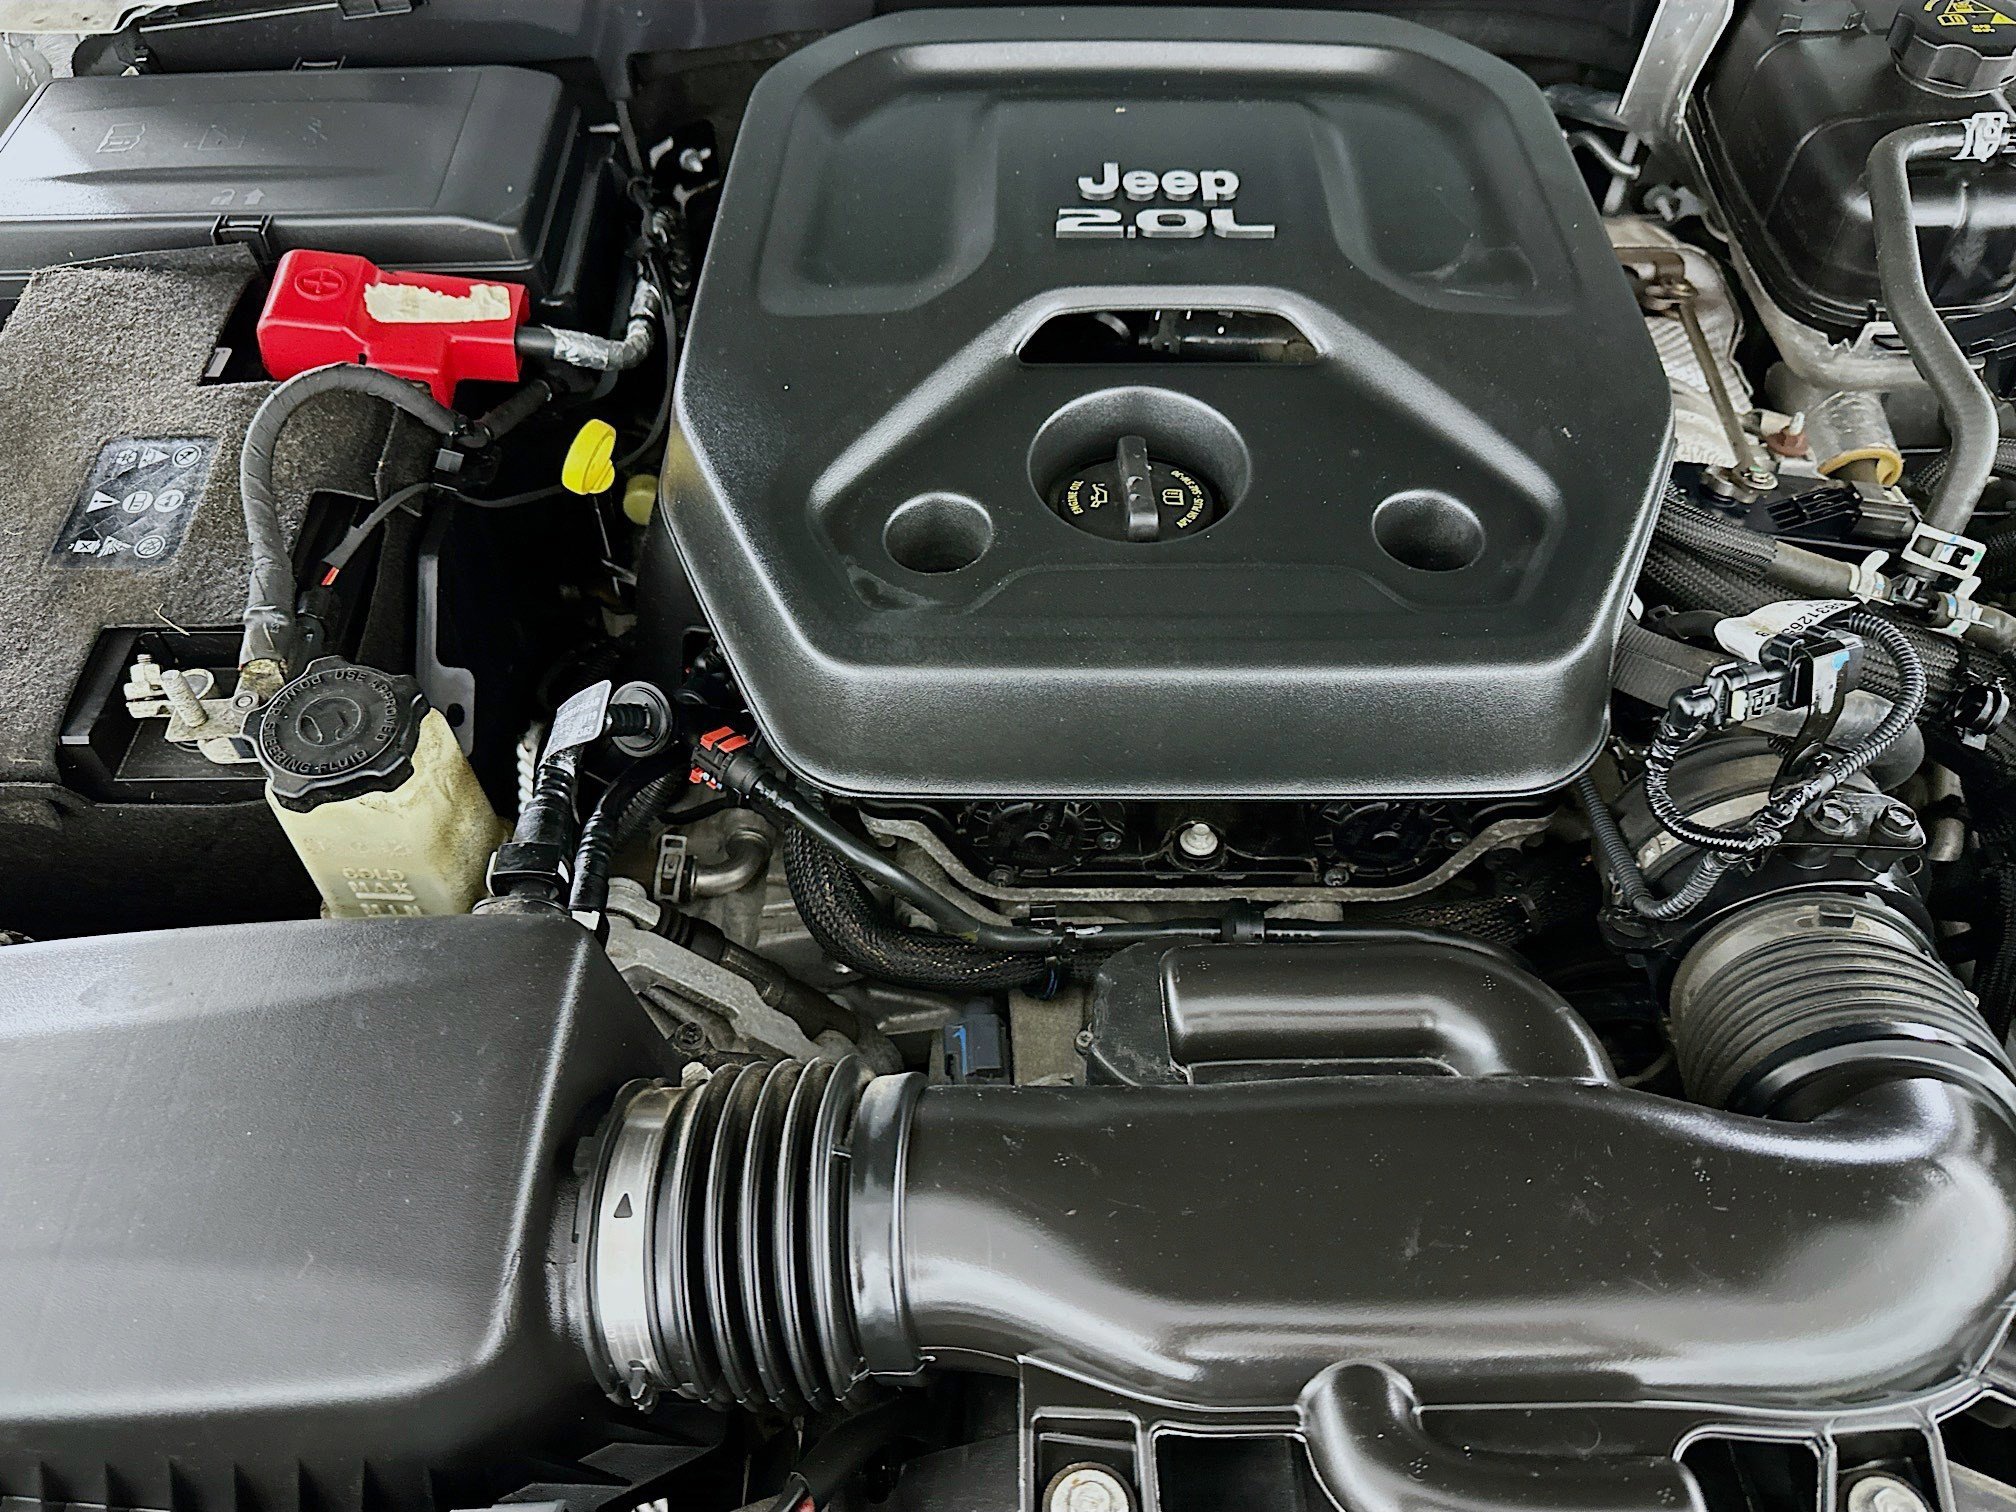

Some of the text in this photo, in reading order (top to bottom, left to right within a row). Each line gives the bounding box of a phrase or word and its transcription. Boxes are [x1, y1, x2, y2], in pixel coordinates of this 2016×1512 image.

[1077, 162, 1240, 207] Jeep
[1055, 208, 1276, 239] 2.0L
[1067, 480, 1085, 515] ENGINE OIL
[262, 673, 368, 773] POWER STEERING FLUID
[334, 670, 397, 742] USE APPROVED
[342, 867, 404, 880] COLD
[347, 881, 413, 895] MAX
